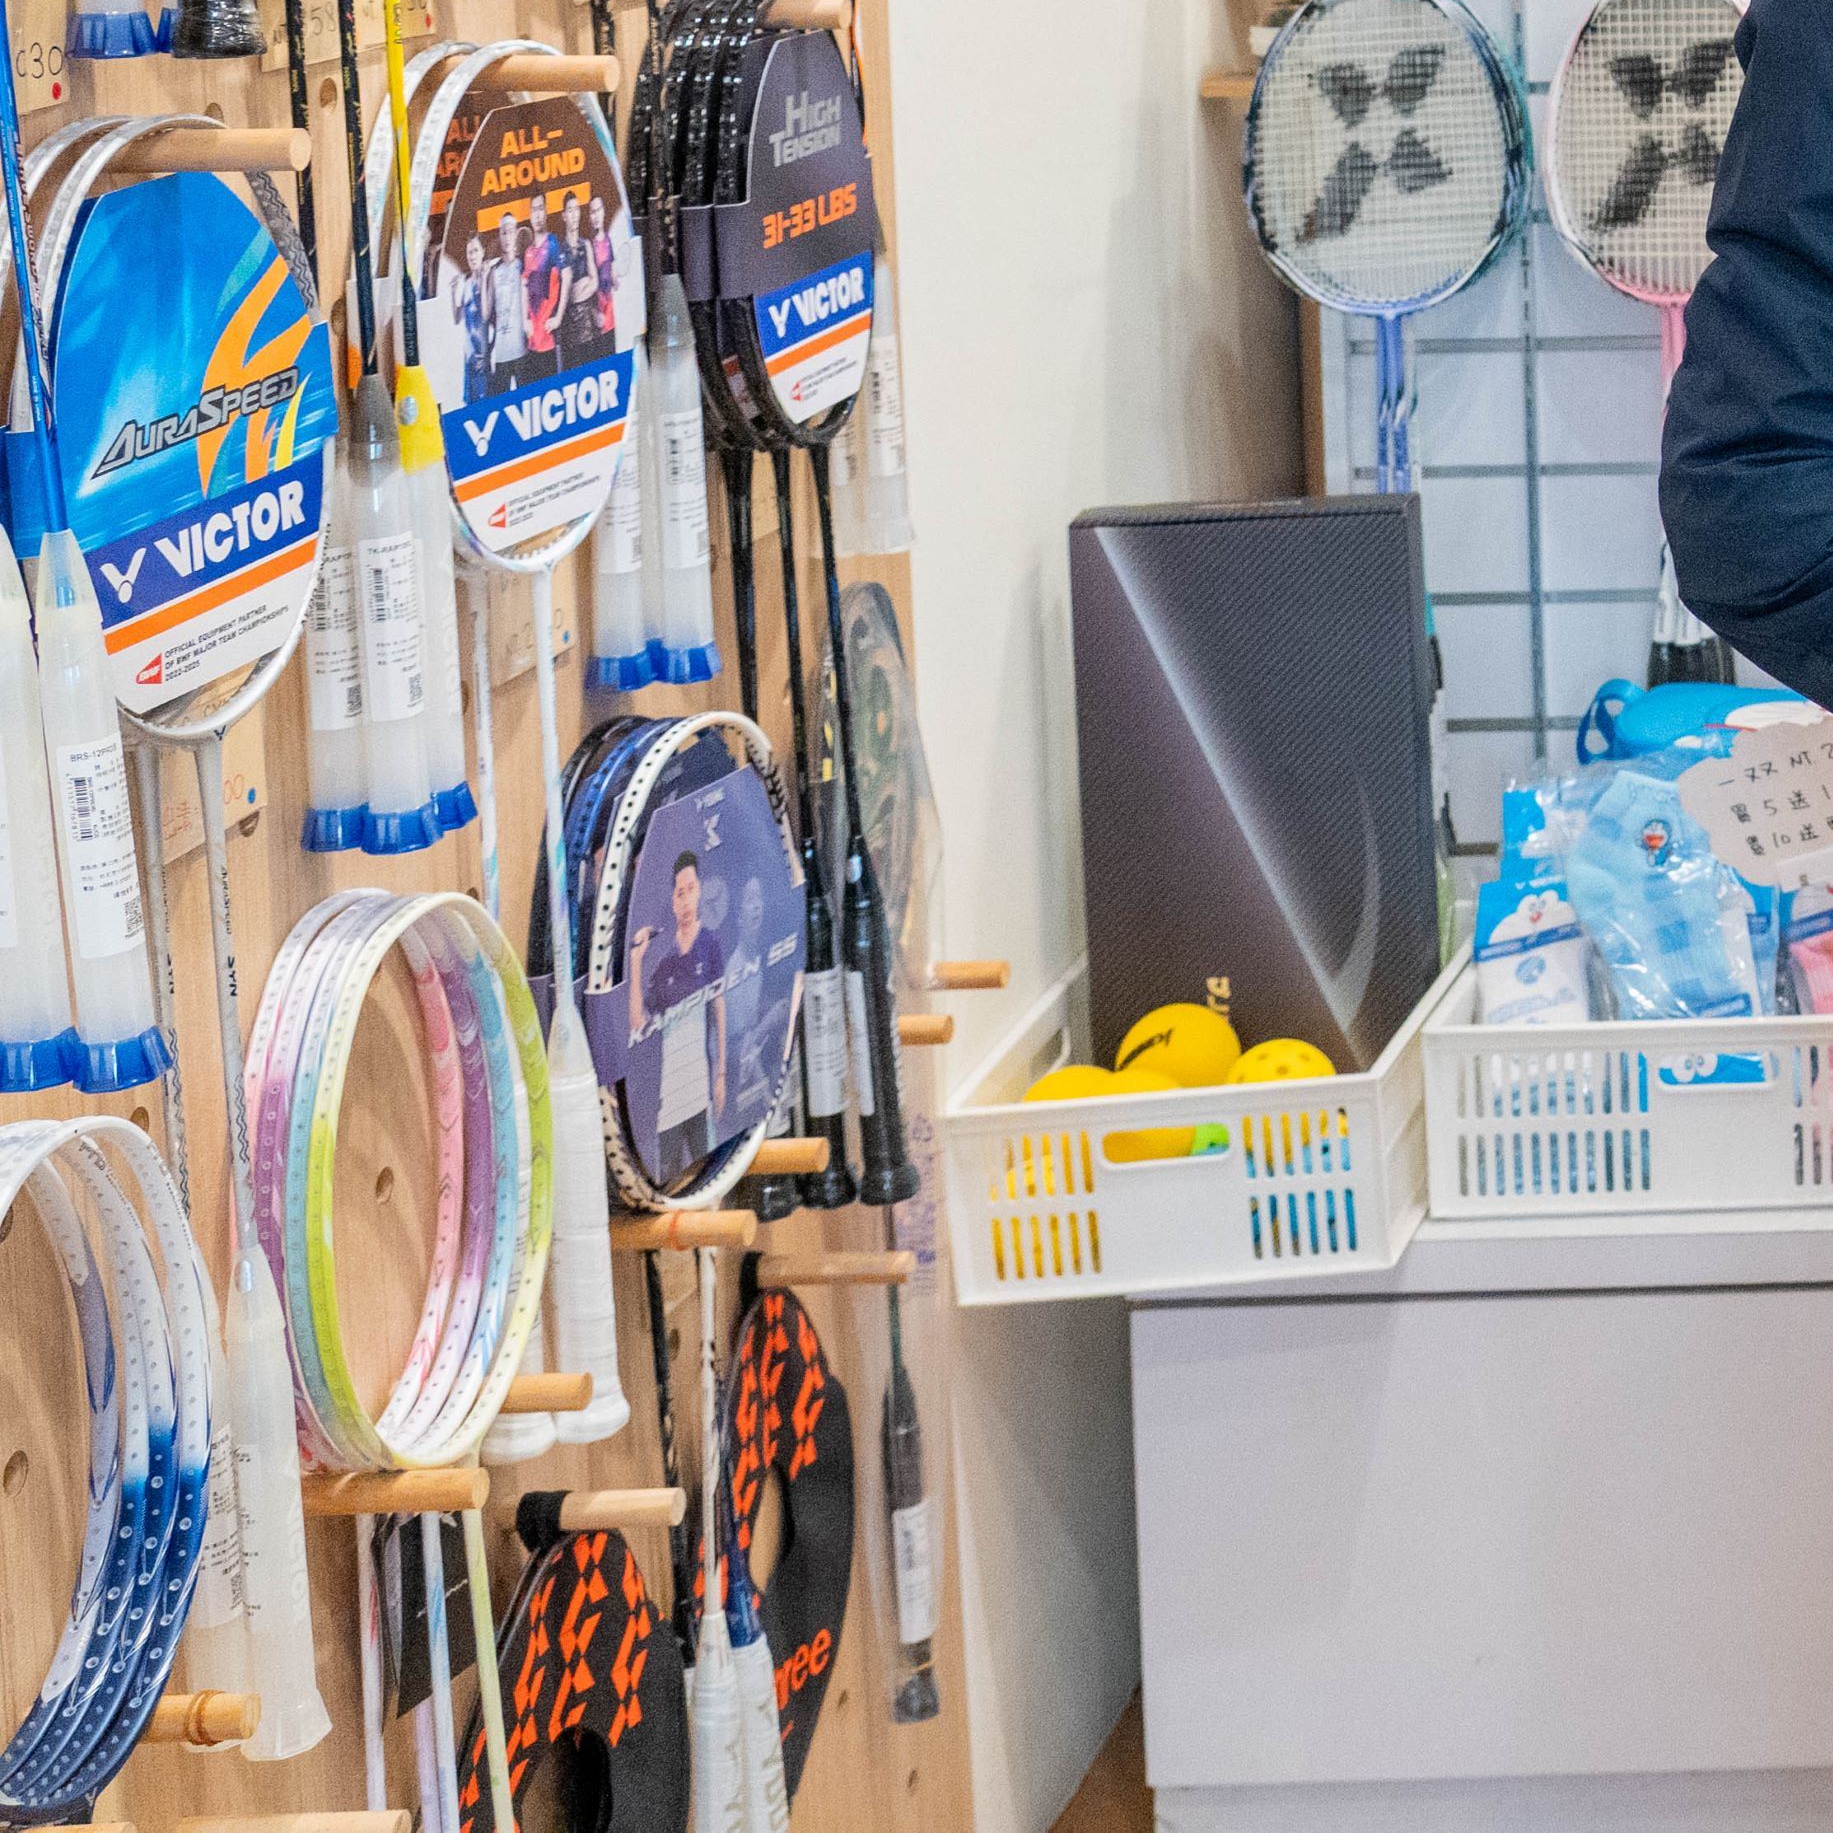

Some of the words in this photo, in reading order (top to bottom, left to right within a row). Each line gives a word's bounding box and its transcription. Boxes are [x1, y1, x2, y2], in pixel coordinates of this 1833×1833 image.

[500, 124, 564, 158] ALL-
[768, 125, 843, 168] TENSION
[480, 147, 586, 197] AROUND
[762, 199, 816, 250] 31-33
[816, 182, 858, 228] LBS
[799, 266, 866, 327] VICTOR
[91, 365, 300, 480] AURASPEED
[504, 369, 620, 443] VICTOR
[154, 479, 306, 580] VICTOR
[165, 637, 195, 659] OFFICIAL
[198, 621, 237, 643] EQUIPMENT
[238, 604, 267, 624] PARTNER
[193, 640, 217, 657] MAJOR
[218, 631, 237, 646] TEAM
